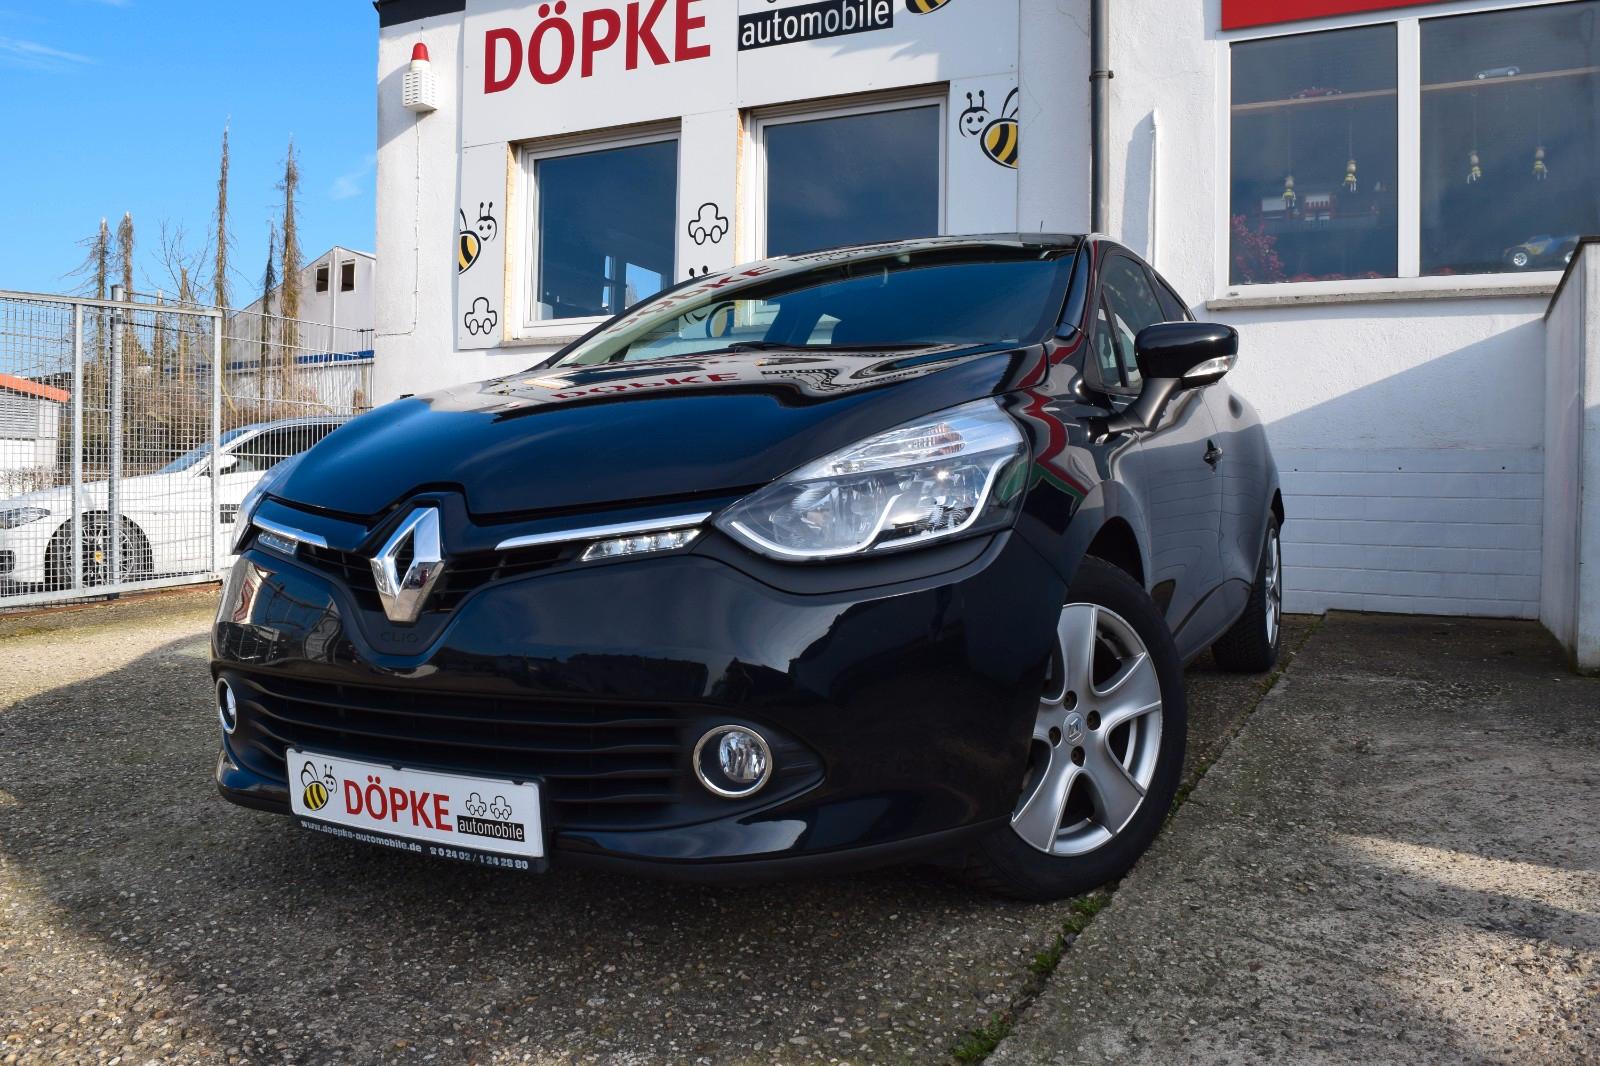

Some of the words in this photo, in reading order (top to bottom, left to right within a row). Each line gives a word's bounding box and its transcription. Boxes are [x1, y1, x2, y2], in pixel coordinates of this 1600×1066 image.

[484, 0, 711, 94] DÖPKE
[739, 0, 889, 47] automobile
[343, 775, 453, 832] DÖPKE
[300, 820, 422, 853] www.doepke-automobile.de
[459, 818, 524, 841] automobile
